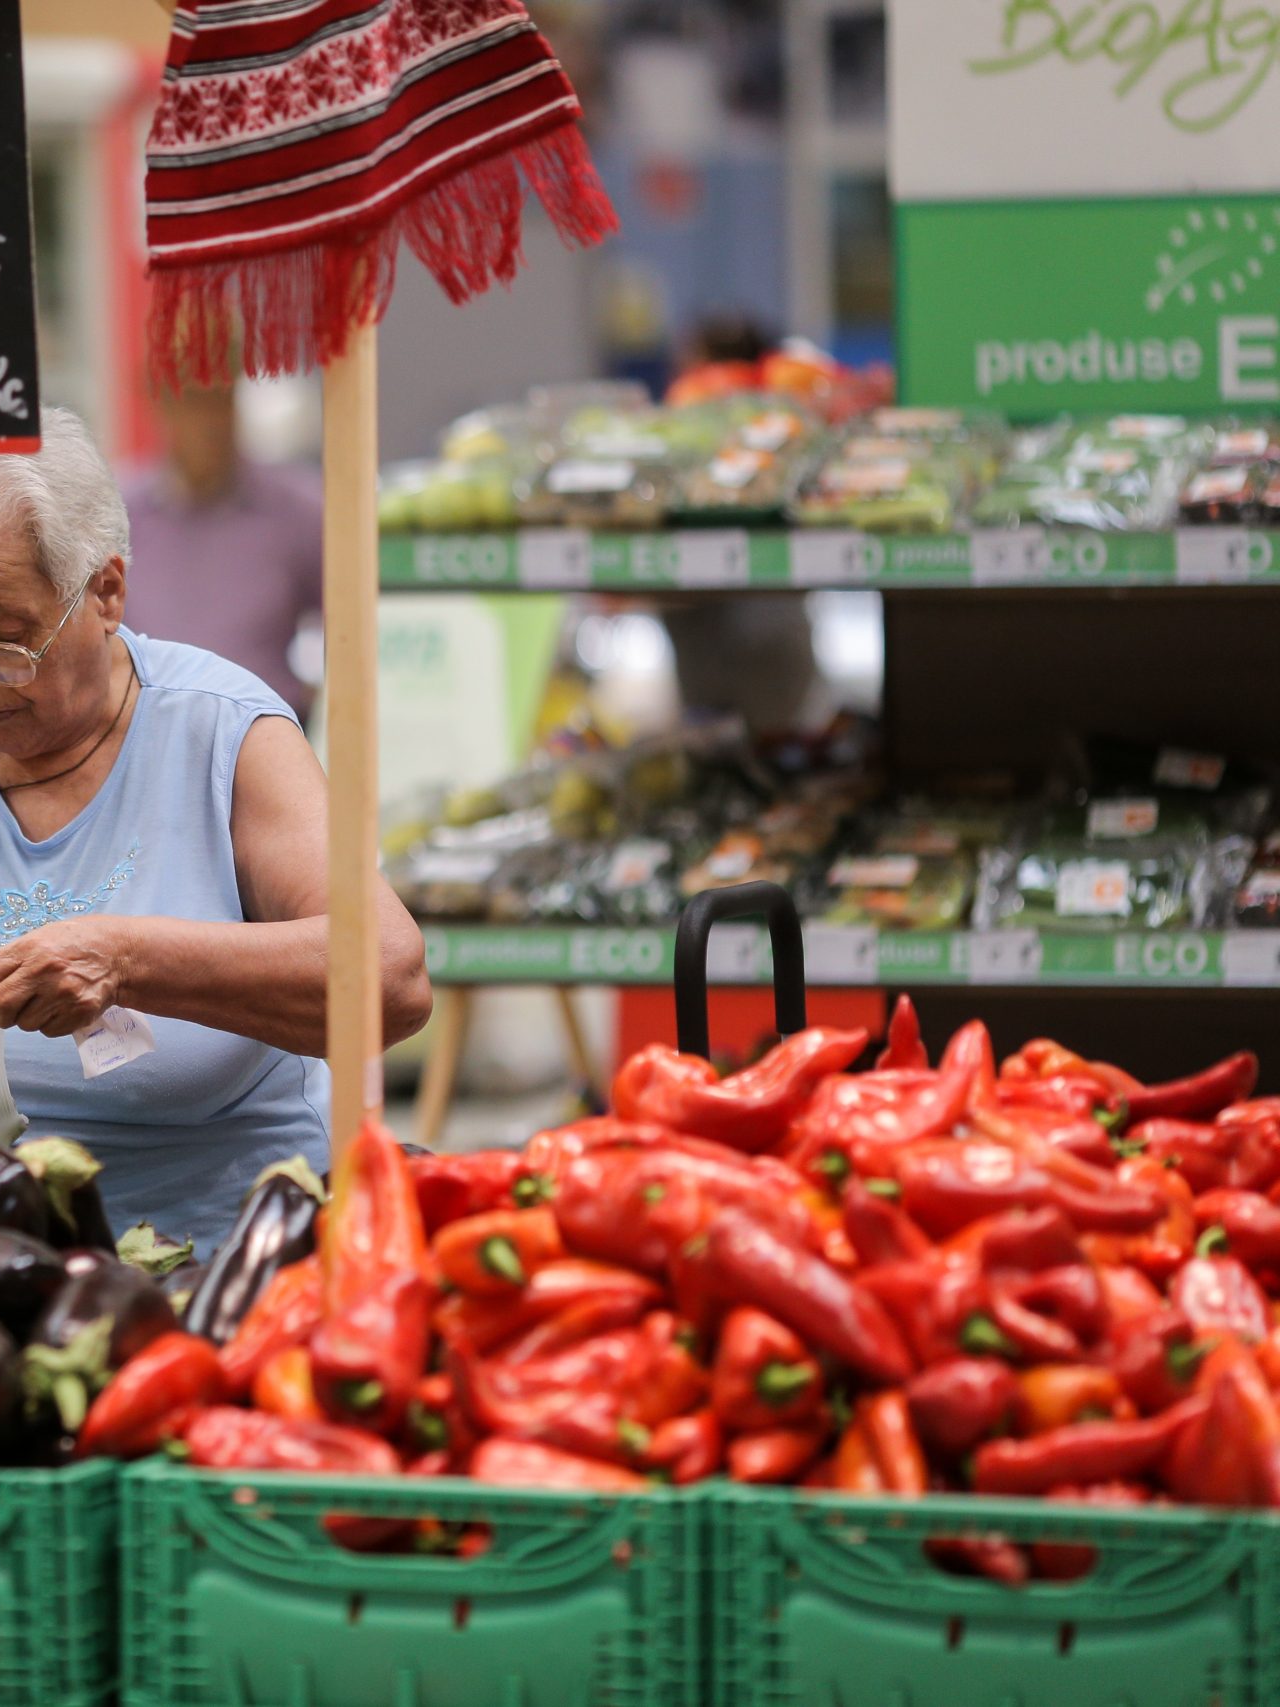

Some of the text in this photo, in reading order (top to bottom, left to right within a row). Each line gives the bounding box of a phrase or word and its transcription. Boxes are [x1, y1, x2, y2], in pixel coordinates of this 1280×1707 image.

[975, 331, 1202, 396] produse
[415, 534, 509, 581] ECO
[572, 929, 664, 974] ECO
[1116, 932, 1209, 977] ECO
